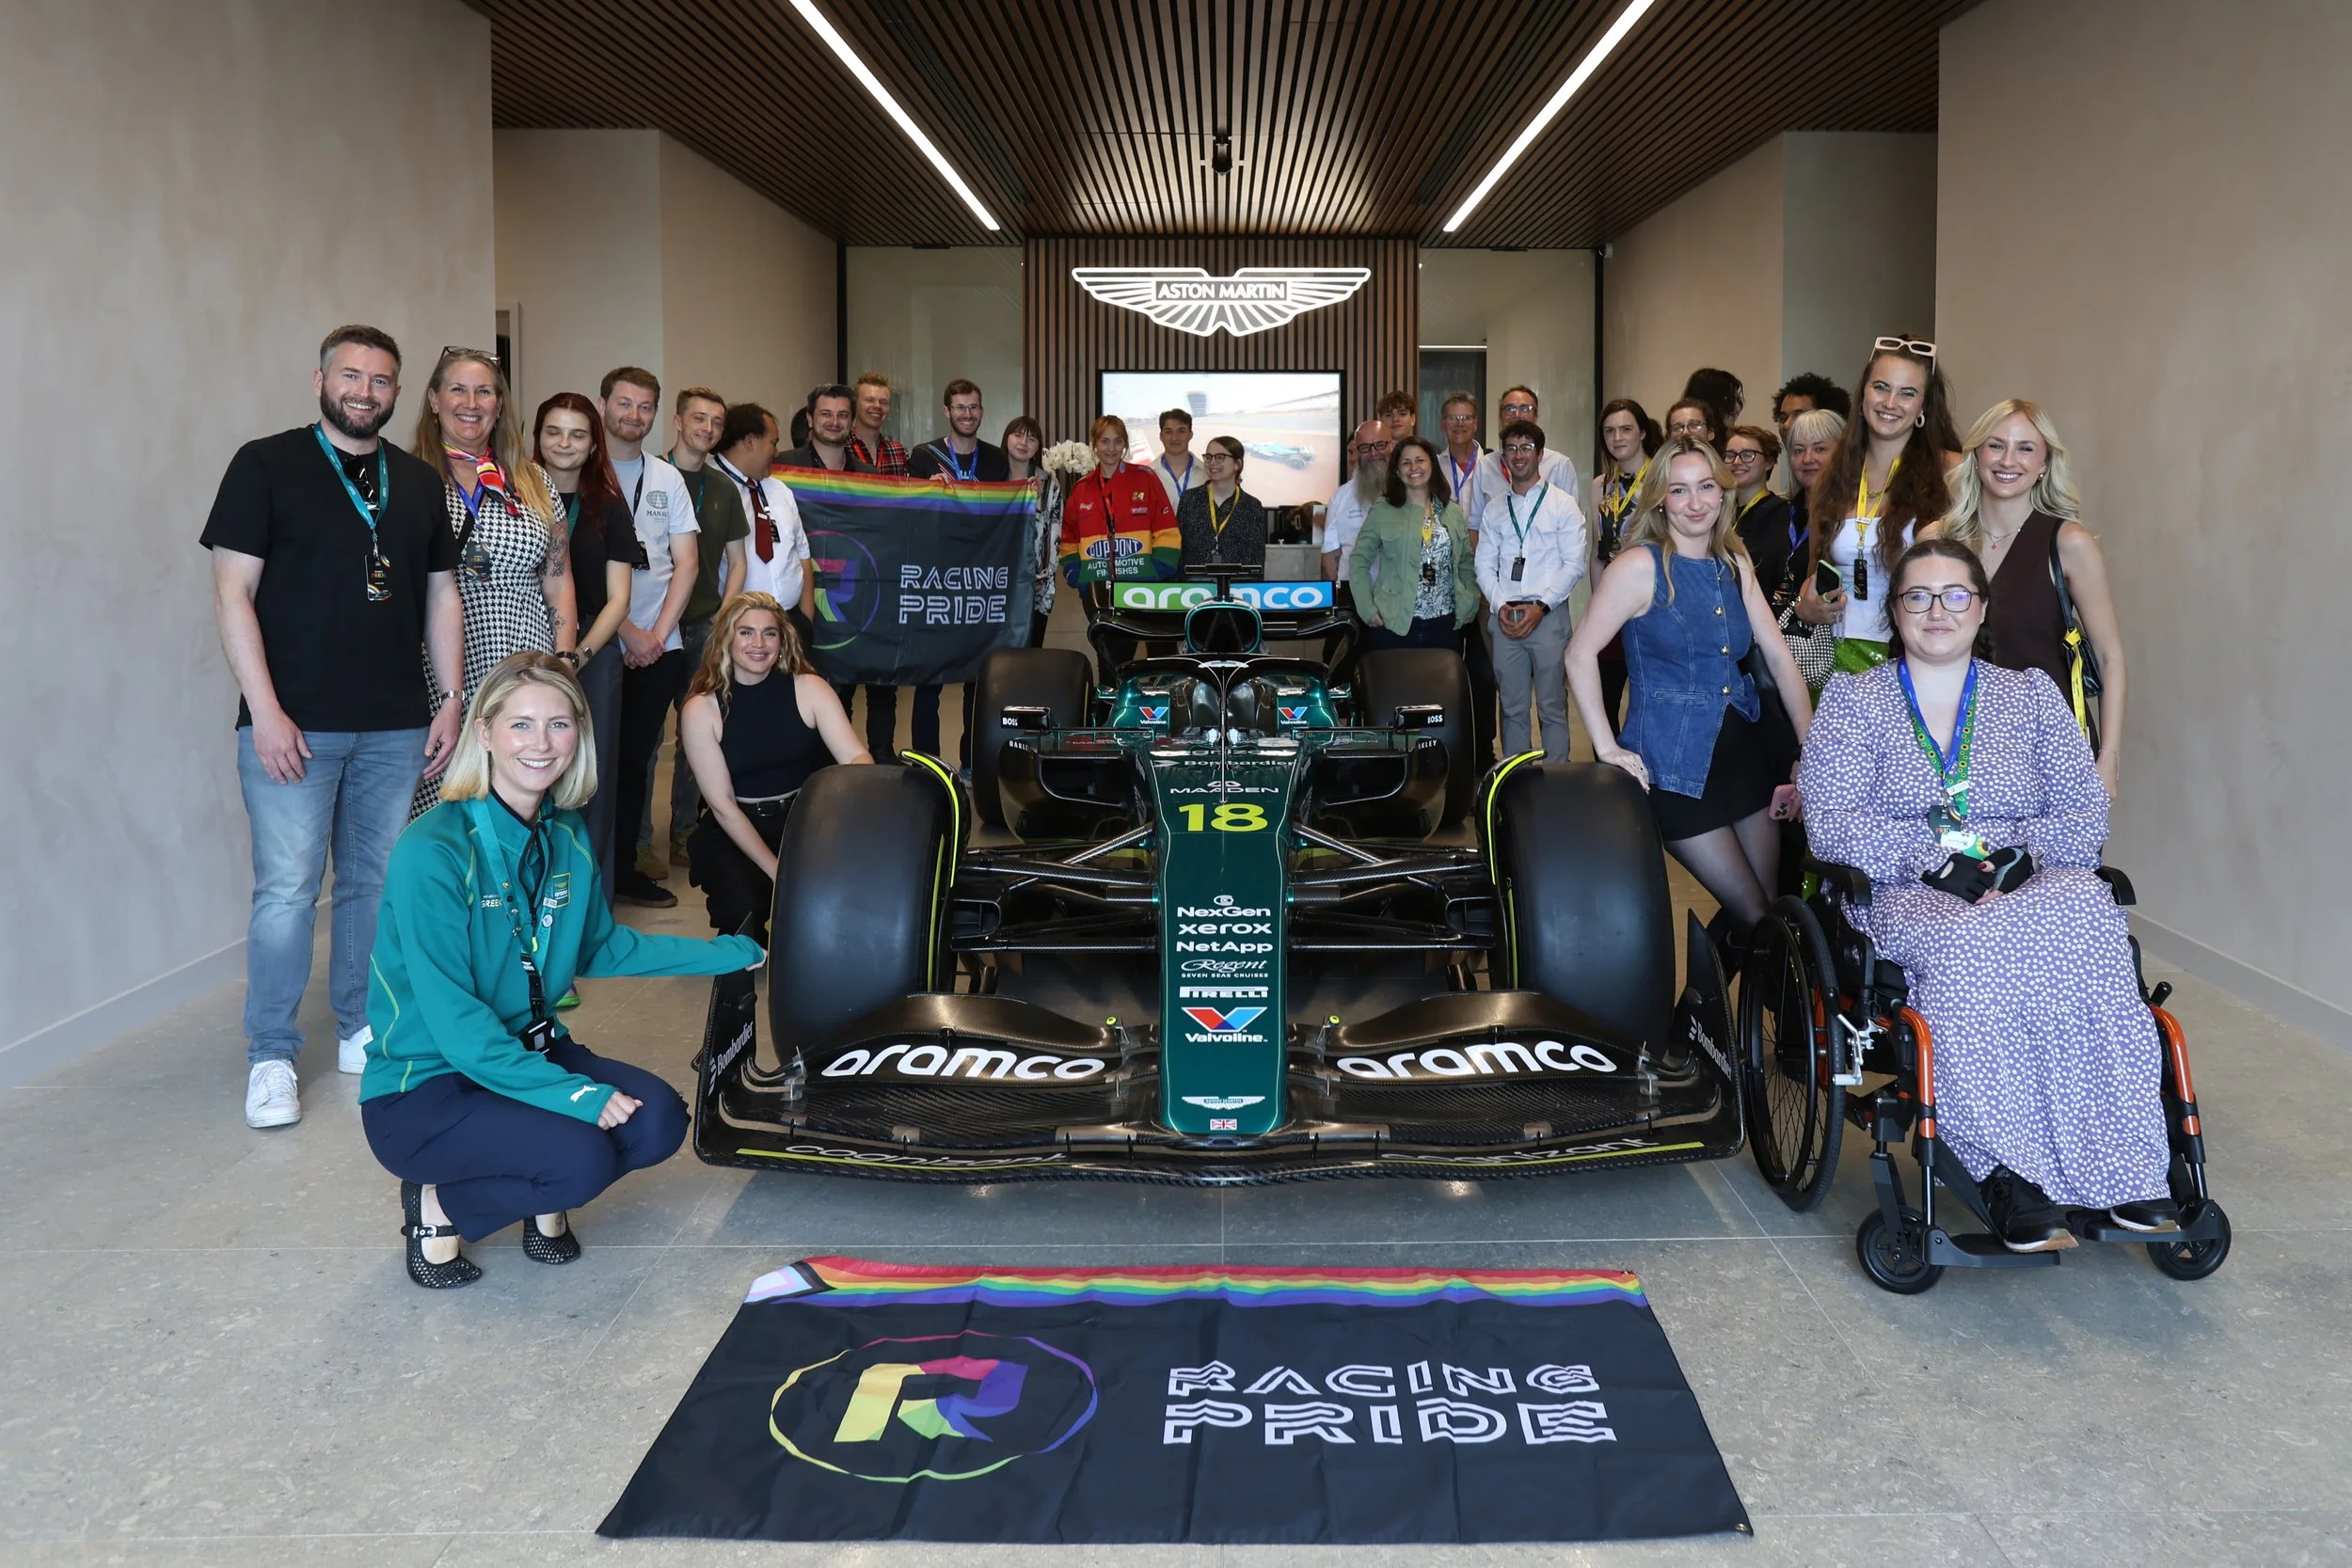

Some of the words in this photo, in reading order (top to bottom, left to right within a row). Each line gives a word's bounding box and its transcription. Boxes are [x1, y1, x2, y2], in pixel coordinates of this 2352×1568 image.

[1158, 283, 1215, 299] ASTON
[1218, 283, 1285, 299] MARTIN
[900, 564, 1009, 590] RACING
[898, 594, 1007, 625] PRIDE
[1178, 802, 1268, 832] 18
[1177, 906, 1271, 917] NexGen
[1178, 923, 1273, 935] xerox
[1176, 941, 1274, 954] NetApp
[1181, 958, 1268, 973] Regent
[1179, 986, 1269, 998] PIRELLI
[717, 1021, 754, 1077] Bombardier
[1184, 1033, 1263, 1042] Valvoline
[820, 1044, 1105, 1080] aramco
[1336, 1040, 1617, 1078] aramco
[785, 1145, 1069, 1165] cognizant
[1168, 1359, 1600, 1396] RACING
[1162, 1398, 1618, 1445] PRIDE
